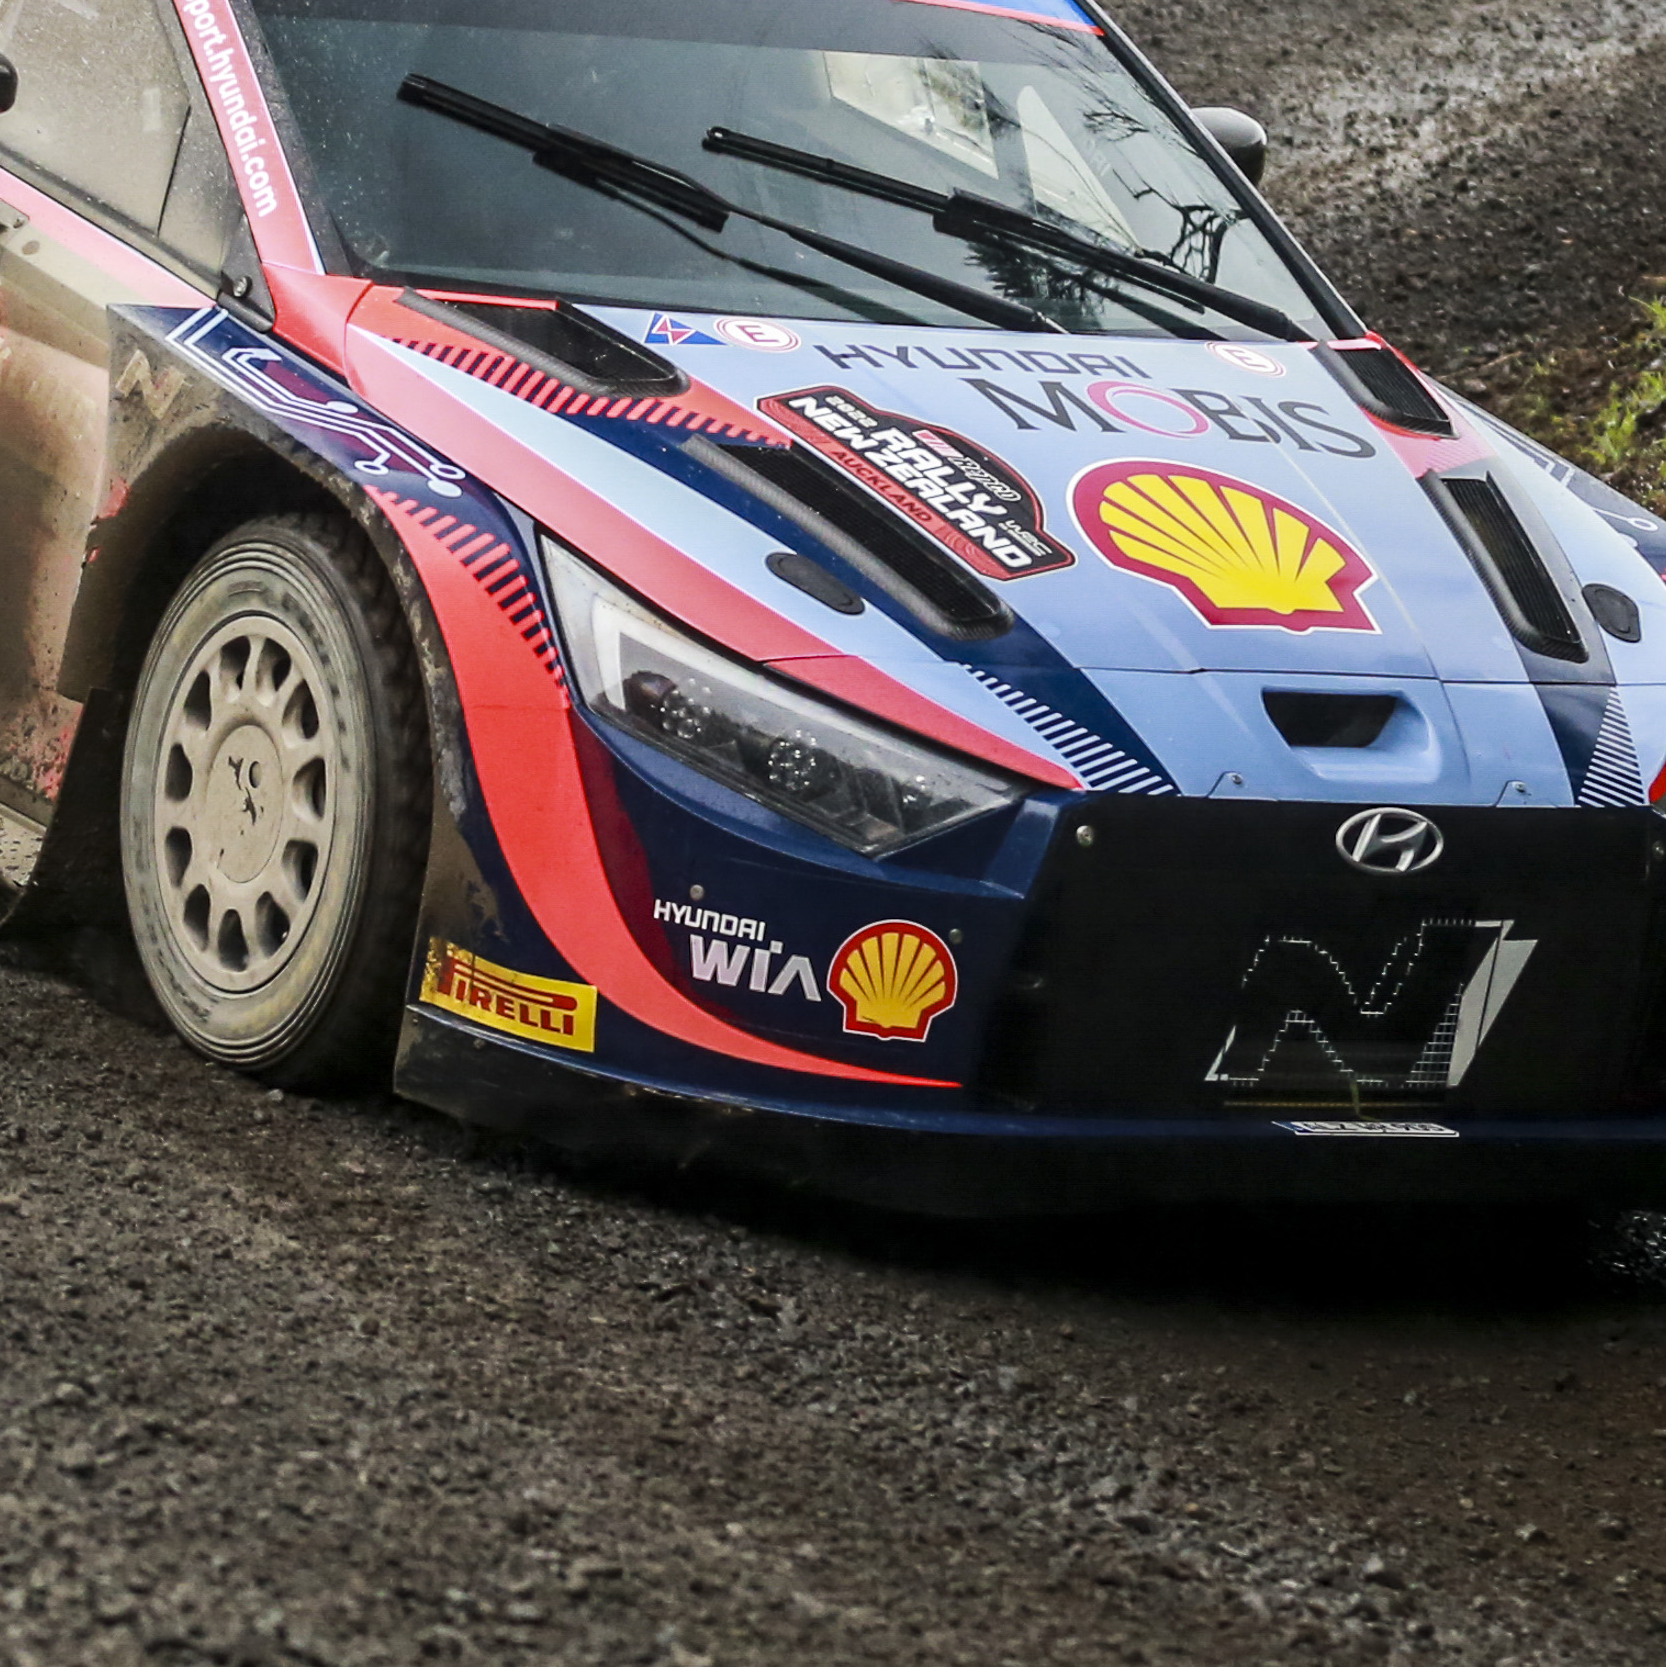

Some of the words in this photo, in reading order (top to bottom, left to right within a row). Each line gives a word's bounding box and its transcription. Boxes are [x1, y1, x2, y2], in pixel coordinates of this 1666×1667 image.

[813, 344, 1152, 379] HYUNDAI
[825, 395, 878, 428] 2022
[958, 378, 1377, 459] MOBIS
[788, 396, 880, 451] NEW
[864, 449, 1033, 568] ZEALAND
[832, 449, 933, 522] AUCKLAND
[870, 427, 1008, 516] RALLY
[653, 899, 766, 942] HYUNDAI
[436, 957, 578, 1036] PIRELLI
